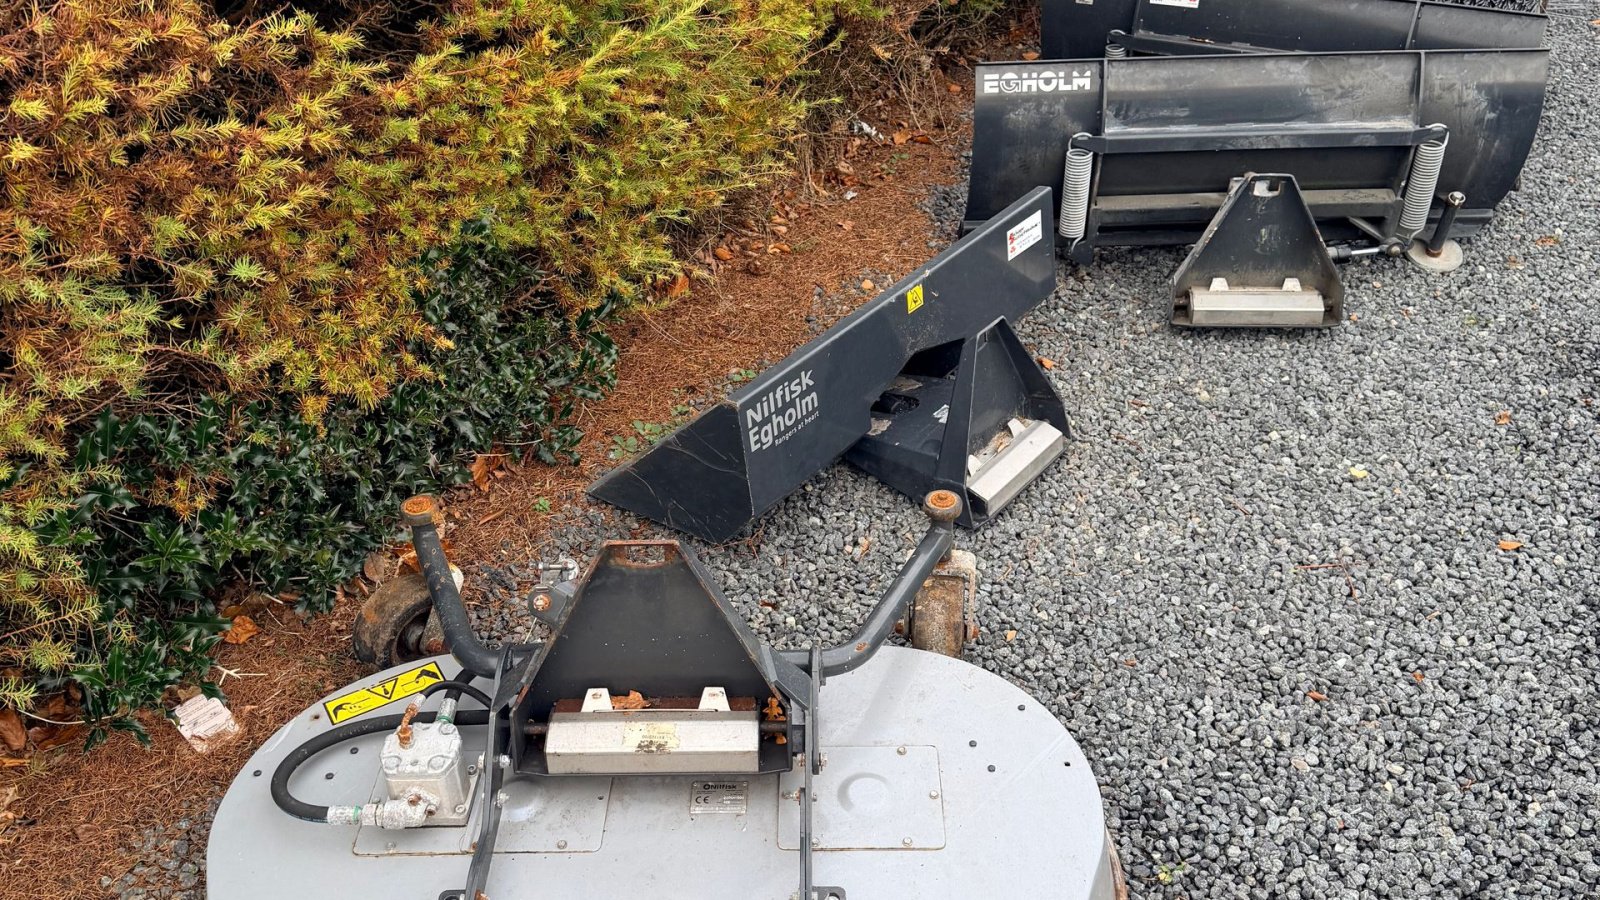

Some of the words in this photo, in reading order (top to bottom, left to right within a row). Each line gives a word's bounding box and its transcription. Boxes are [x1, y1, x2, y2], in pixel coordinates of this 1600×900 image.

[983, 70, 1091, 93] EGHOLM
[746, 369, 815, 429] Nilfisk
[749, 391, 819, 453] Egholm
[774, 427, 798, 447] Rangers
[797, 422, 805, 430] at
[804, 410, 820, 425] heart
